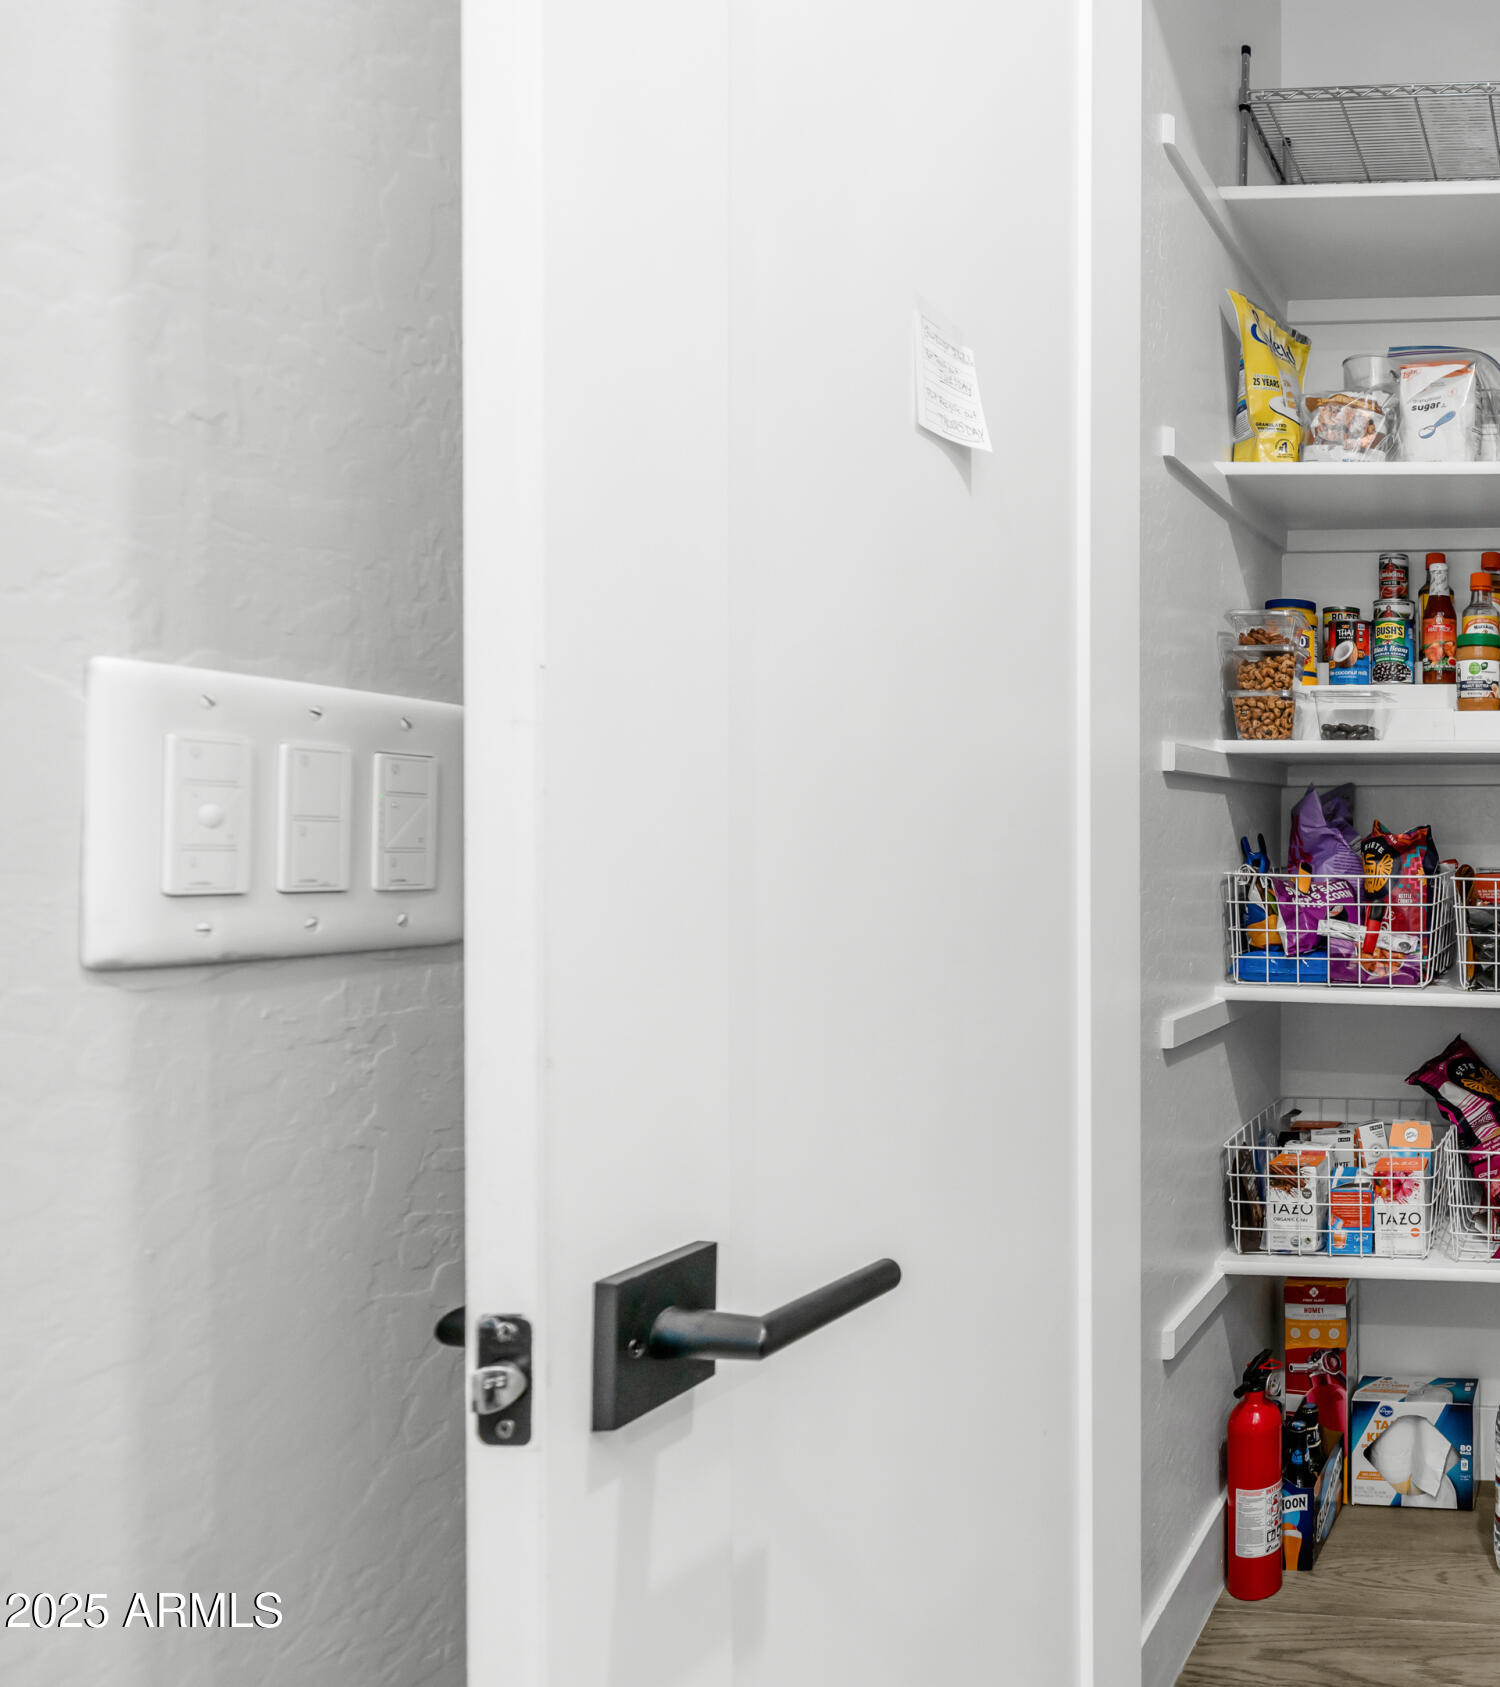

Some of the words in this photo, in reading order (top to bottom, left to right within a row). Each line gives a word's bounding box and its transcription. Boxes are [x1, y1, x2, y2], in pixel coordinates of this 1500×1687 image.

[1252, 377, 1261, 386] 25
[1262, 377, 1280, 388] YEARS
[1411, 401, 1441, 412] sugar
[1376, 625, 1403, 637] BUSH'S
[1377, 1212, 1422, 1226] TAZO
